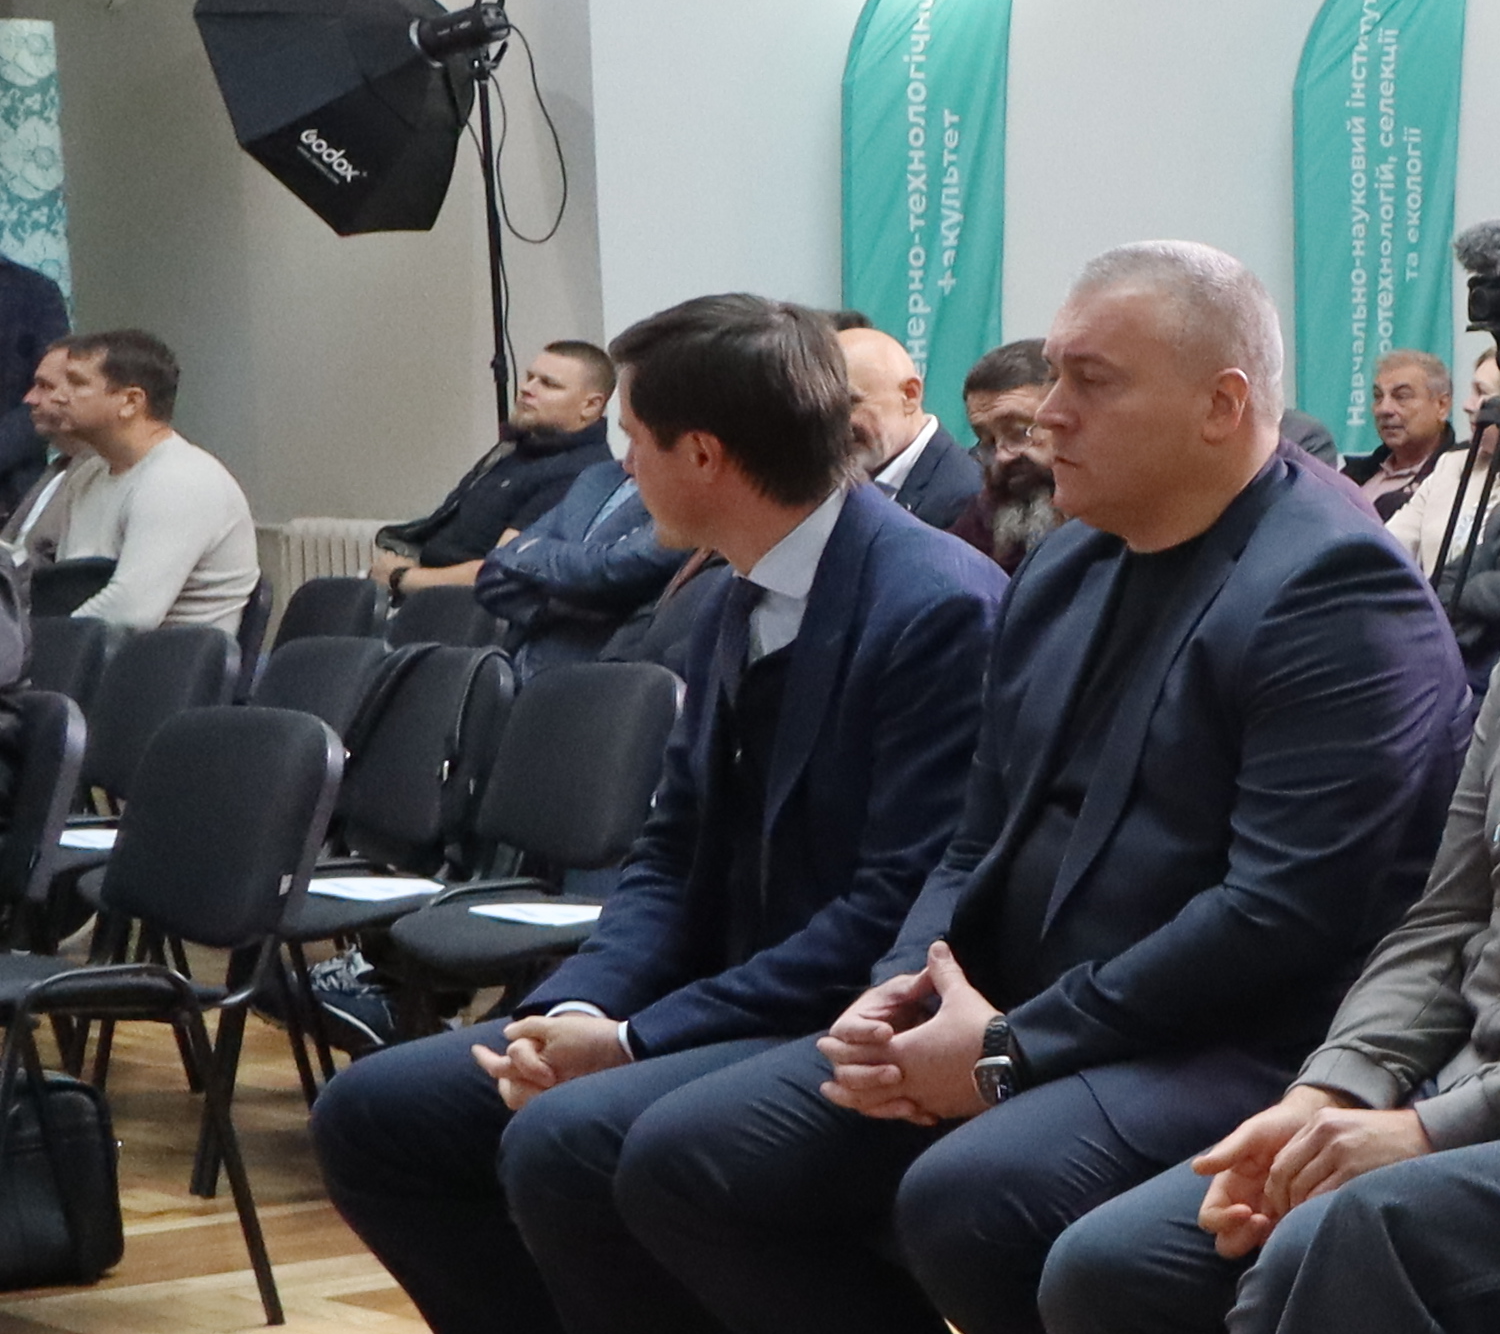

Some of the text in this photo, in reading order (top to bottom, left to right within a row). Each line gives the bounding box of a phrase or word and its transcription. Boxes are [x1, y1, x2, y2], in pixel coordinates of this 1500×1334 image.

[300, 129, 361, 183] Godox
[1377, 27, 1400, 148] селекції
[1346, 115, 1370, 426] Навчально-науковий
[1403, 126, 1423, 283] та екології
